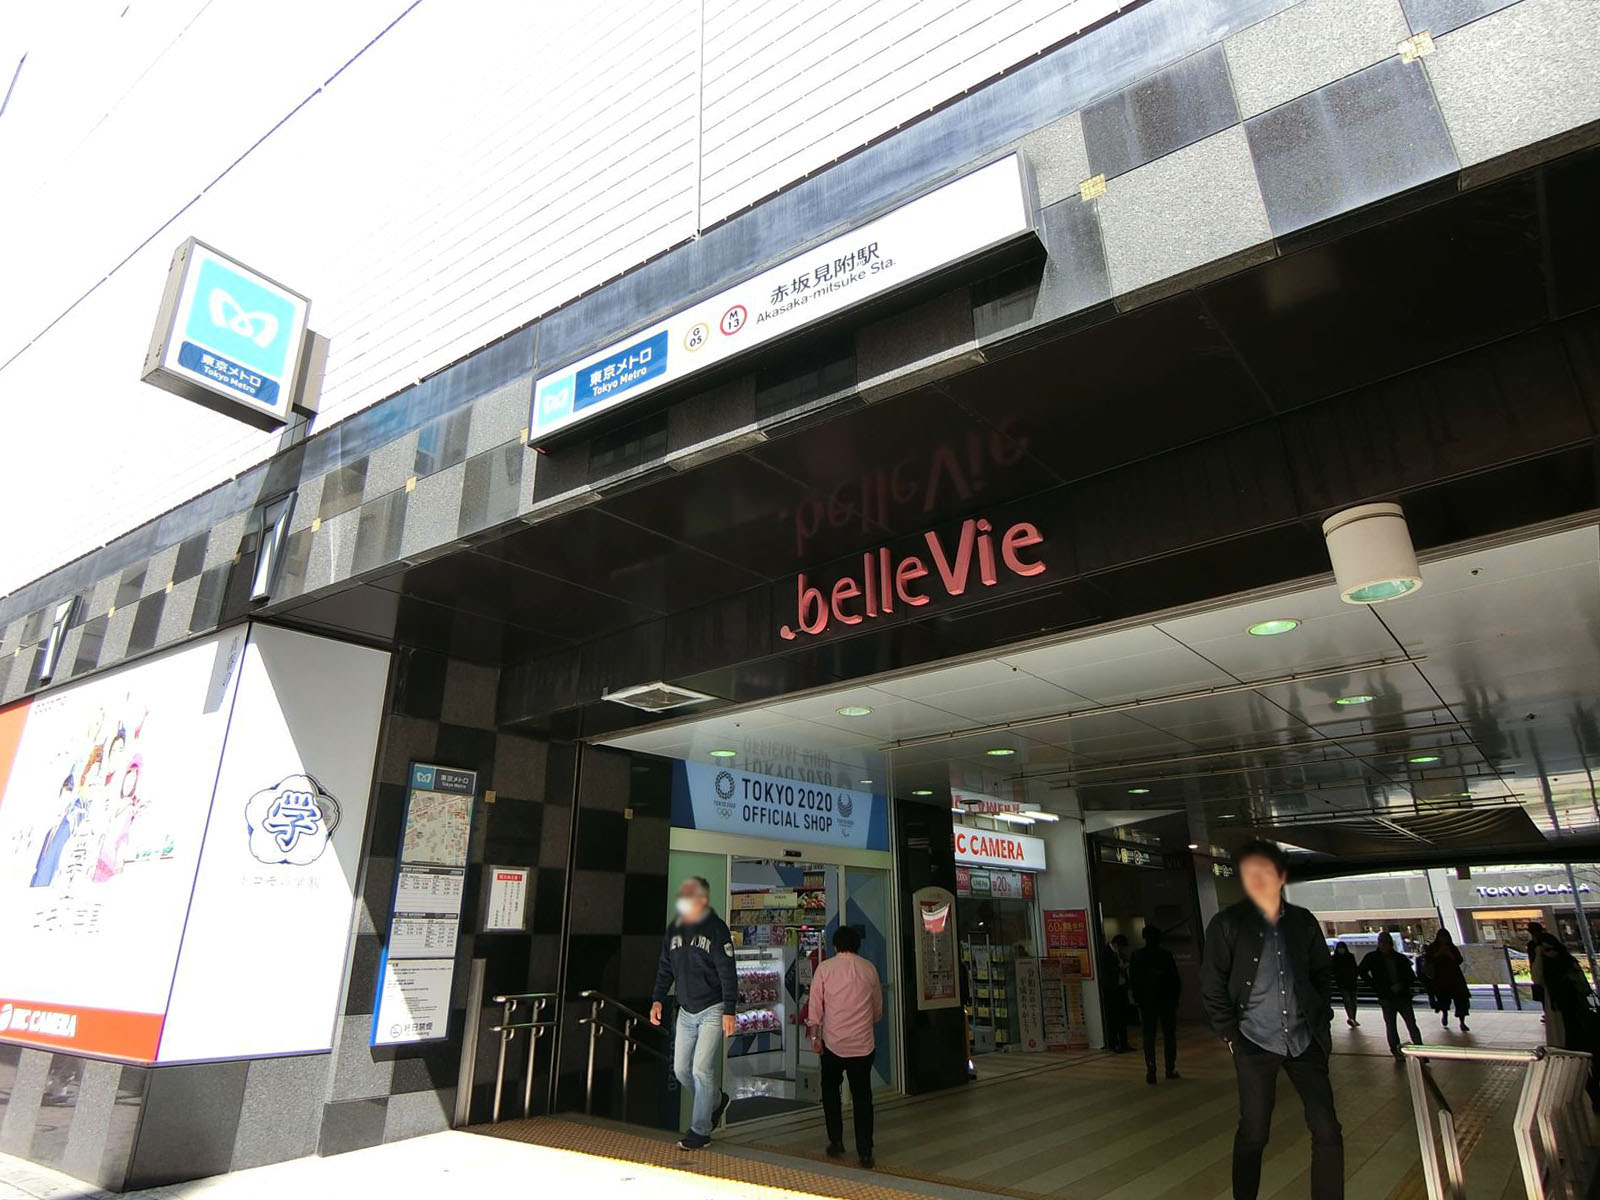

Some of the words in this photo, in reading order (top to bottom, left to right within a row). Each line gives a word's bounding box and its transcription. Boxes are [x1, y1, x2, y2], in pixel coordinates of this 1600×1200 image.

[769, 241, 880, 306] 赤坂見附駅
[756, 270, 867, 325] Akasaka-mitsuke
[871, 257, 897, 275] Sta.
[726, 318, 740, 331] 13
[728, 309, 739, 320] M
[689, 335, 702, 348] 05
[692, 327, 700, 337] G
[201, 353, 262, 387] 東京メトロ
[203, 365, 229, 382] Tokyo
[230, 377, 256, 394] Metro
[589, 346, 652, 387] 東京メトロ
[592, 380, 618, 397] Tokyo
[620, 366, 647, 385] Metro
[741, 778, 794, 806] TOKYO
[798, 788, 832, 812] 2020
[742, 805, 800, 829] OFFICIAL
[803, 813, 833, 833] SHOP
[970, 835, 1024, 860] CAMERA
[1476, 885, 1529, 898] TOKYU
